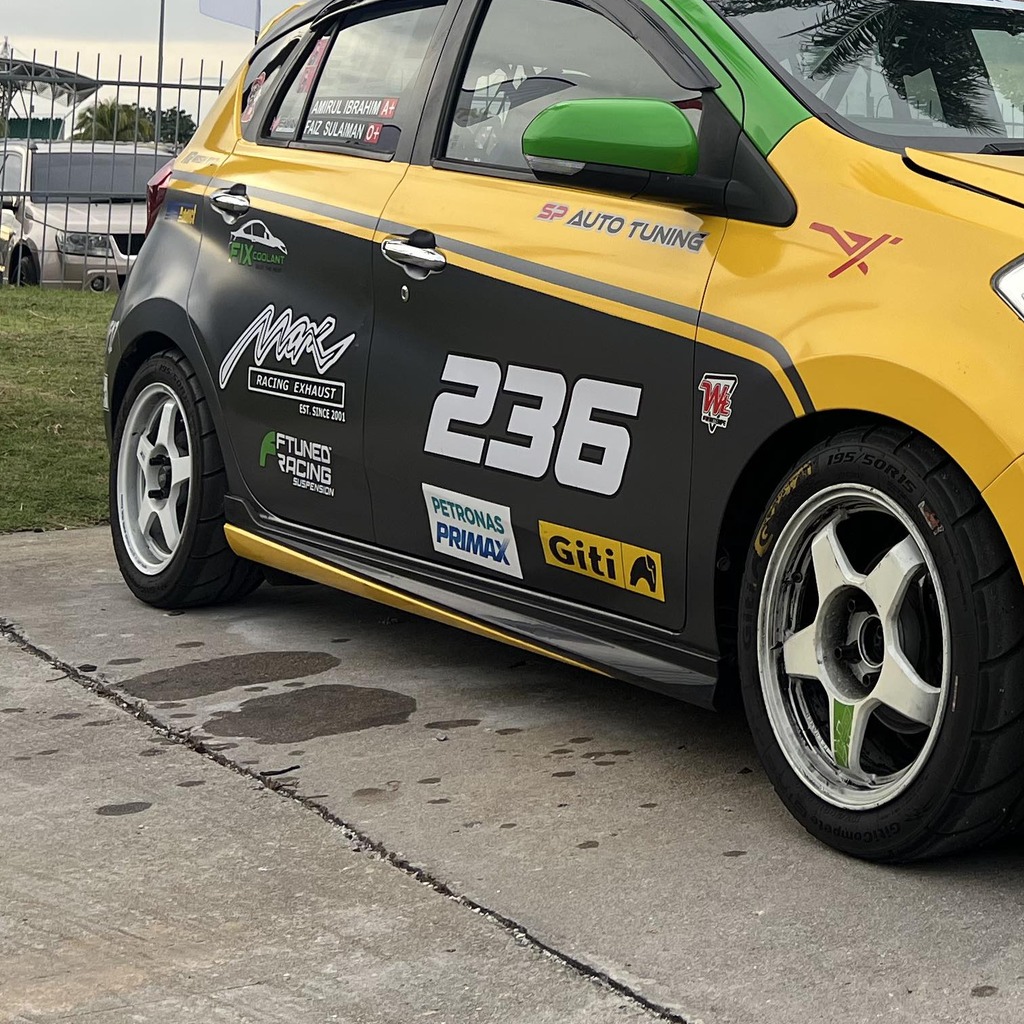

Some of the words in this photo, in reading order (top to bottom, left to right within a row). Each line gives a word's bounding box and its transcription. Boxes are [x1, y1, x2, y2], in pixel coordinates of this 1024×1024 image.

[311, 99, 341, 114] AMIRUL
[343, 100, 381, 116] IBRAHIM
[381, 101, 396, 116] A+
[304, 120, 320, 135] FAIZ
[323, 121, 364, 139] SULAIMAN
[537, 203, 569, 221] SP
[567, 209, 625, 234] AUTO
[628, 221, 710, 251] TUNING
[230, 241, 254, 267] FIX
[252, 250, 285, 265] COOLANT
[256, 374, 289, 392] RACING
[293, 382, 337, 400] EXHAUST
[299, 403, 312, 415] EST.
[312, 406, 330, 420] SINCE
[331, 410, 346, 422] 2001
[423, 353, 643, 497] 236
[276, 432, 332, 465] FTUNED
[277, 453, 332, 485] RACING
[826, 451, 918, 495] 195/50R15
[292, 477, 335, 497] SUSPENSION
[431, 496, 505, 535] PETRONAS
[436, 521, 511, 566] PRIMAX
[549, 535, 617, 580] Giti
